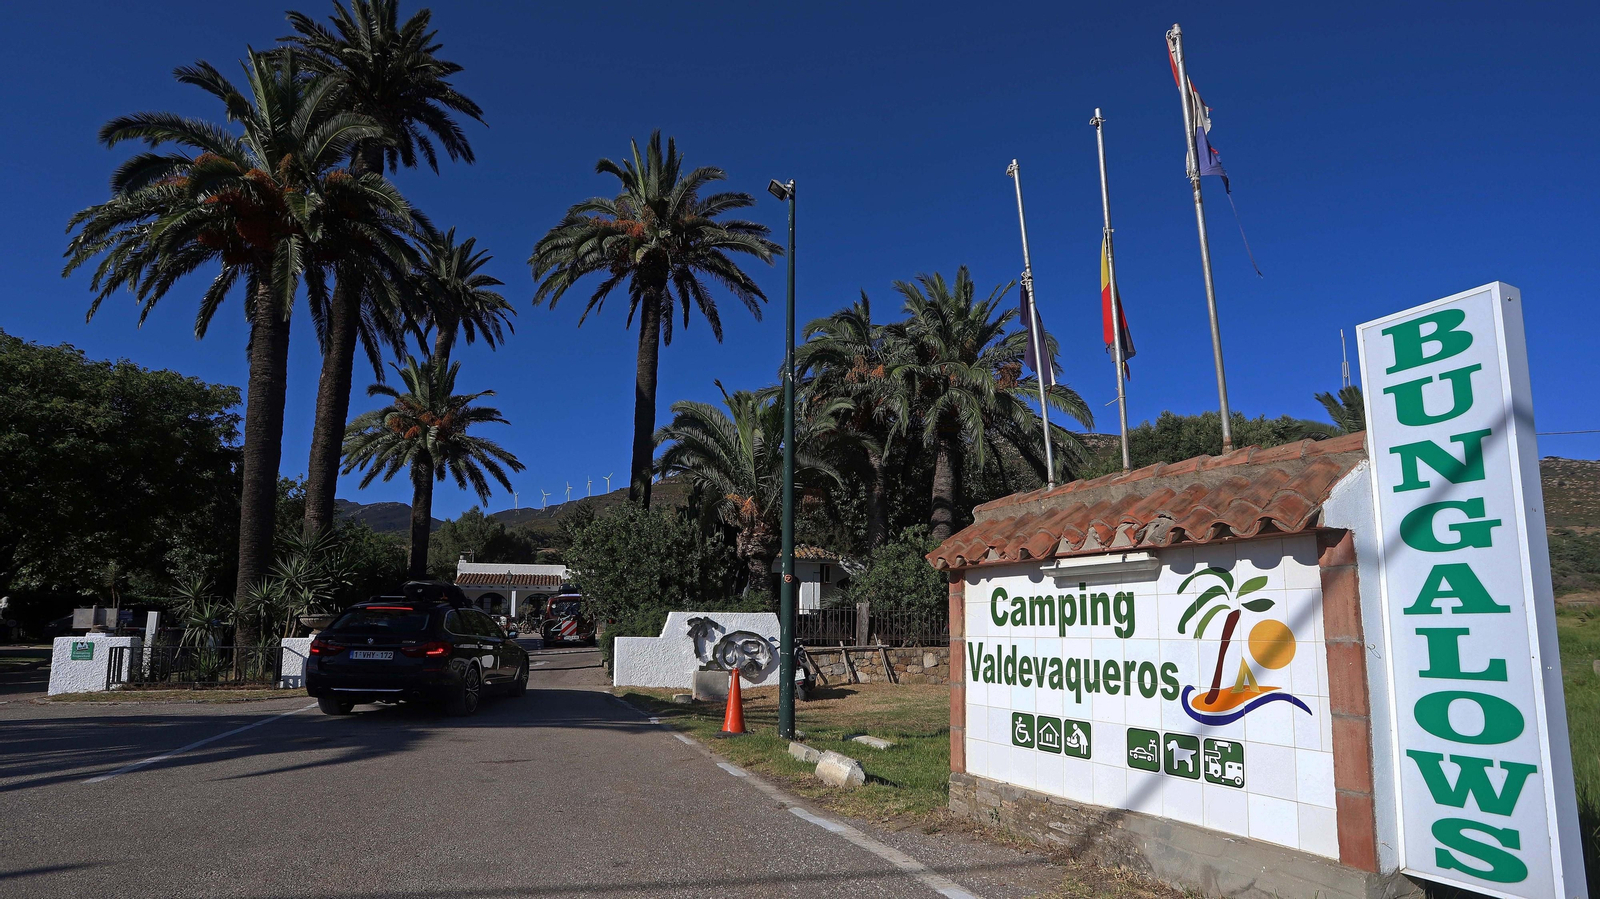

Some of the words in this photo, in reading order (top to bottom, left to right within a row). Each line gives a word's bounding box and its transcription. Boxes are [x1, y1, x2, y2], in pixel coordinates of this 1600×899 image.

[990, 582, 1136, 639] Camping
[1381, 308, 1538, 884] BUNGALOWS
[967, 641, 1181, 704] Valdevaqueros
